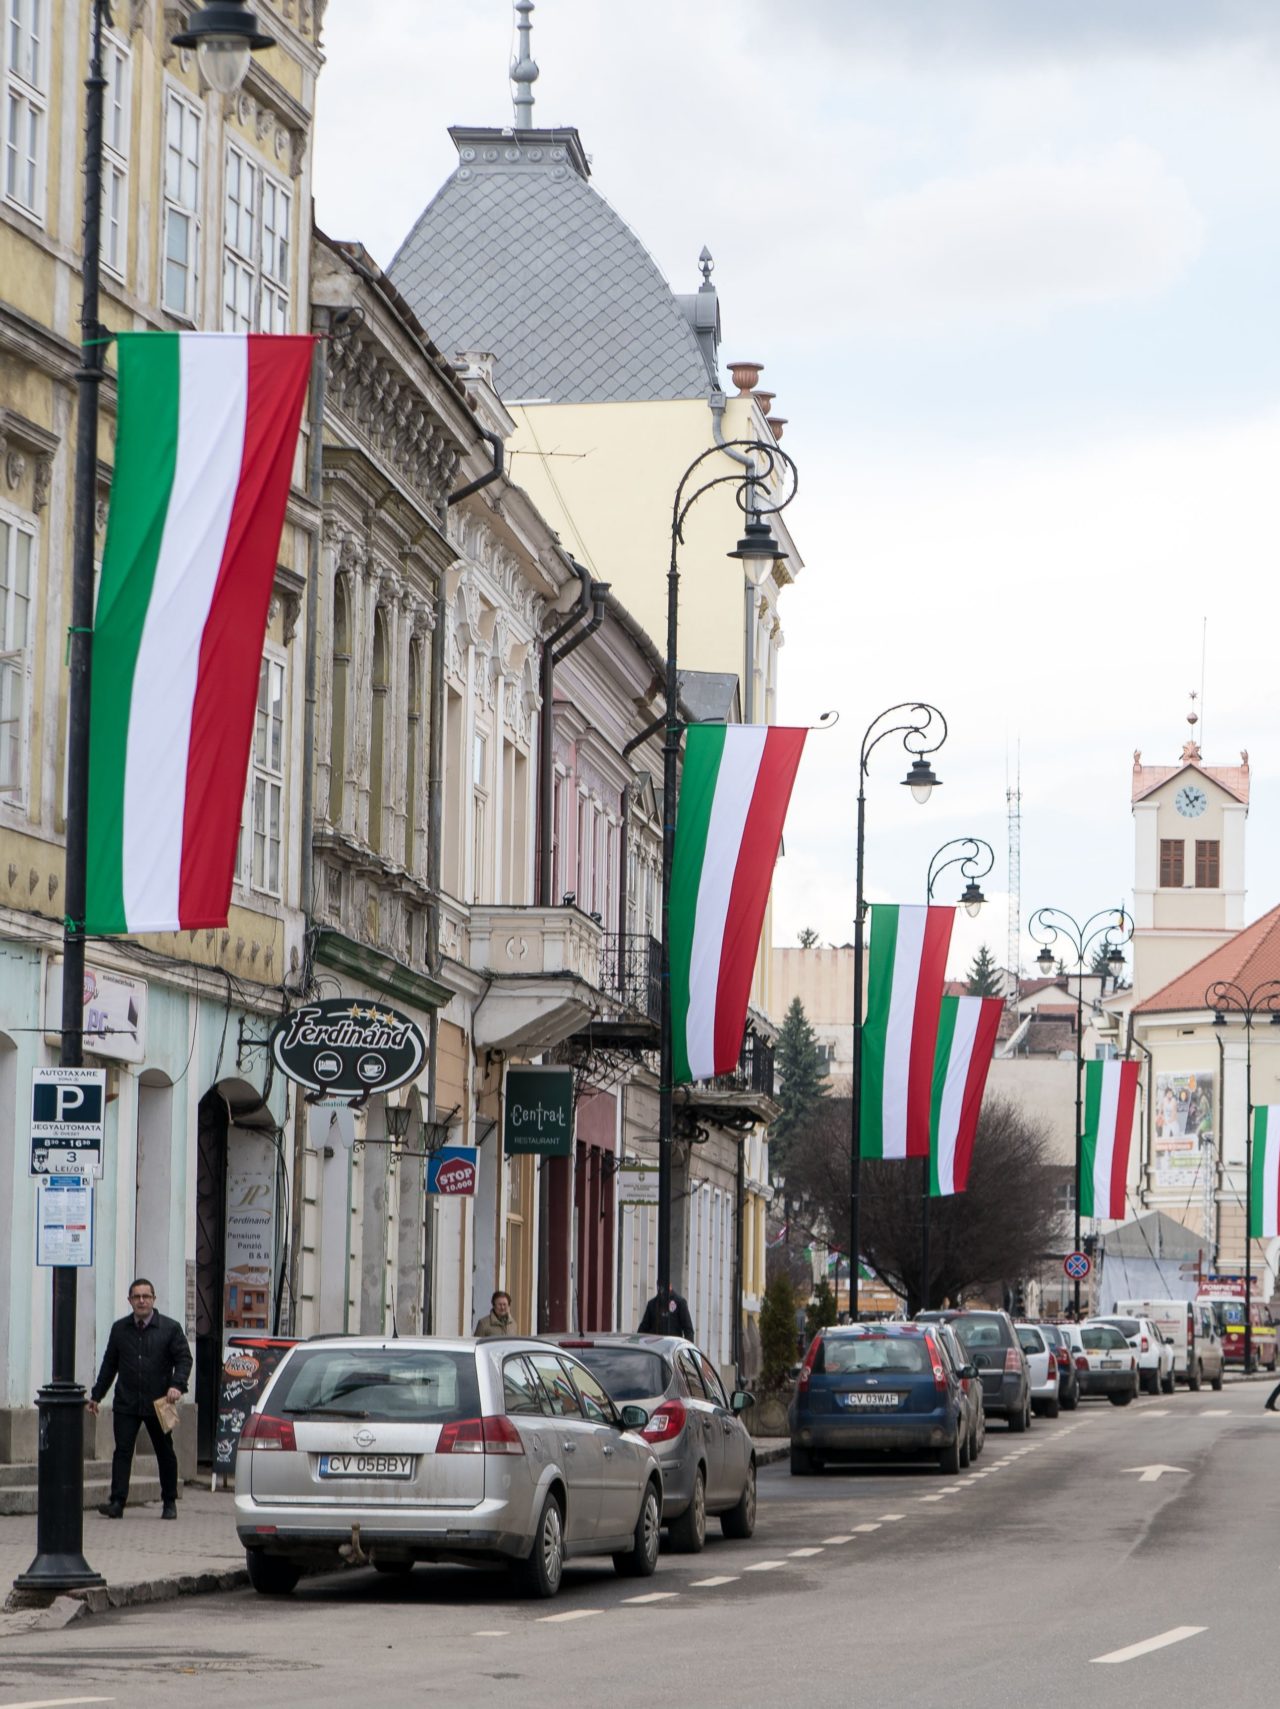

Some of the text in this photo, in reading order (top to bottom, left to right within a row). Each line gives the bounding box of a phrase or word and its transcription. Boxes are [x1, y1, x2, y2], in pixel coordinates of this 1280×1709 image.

[284, 1007, 413, 1050] Ferdinánd
[55, 1085, 84, 1121] P
[511, 1101, 566, 1131] Central
[32, 1123, 101, 1131] JEGYAUTOMATA
[514, 1137, 560, 1145] RESTAURANT
[66, 1151, 77, 1163] 3
[55, 1165, 85, 1173] LEI/OR
[440, 1167, 473, 1186] STOP
[446, 1180, 473, 1193] 10.000
[228, 1216, 271, 1225] Ferdinand
[227, 1232, 261, 1240] Pensiune
[849, 1393, 865, 1405] CV
[329, 1456, 352, 1471] CV
